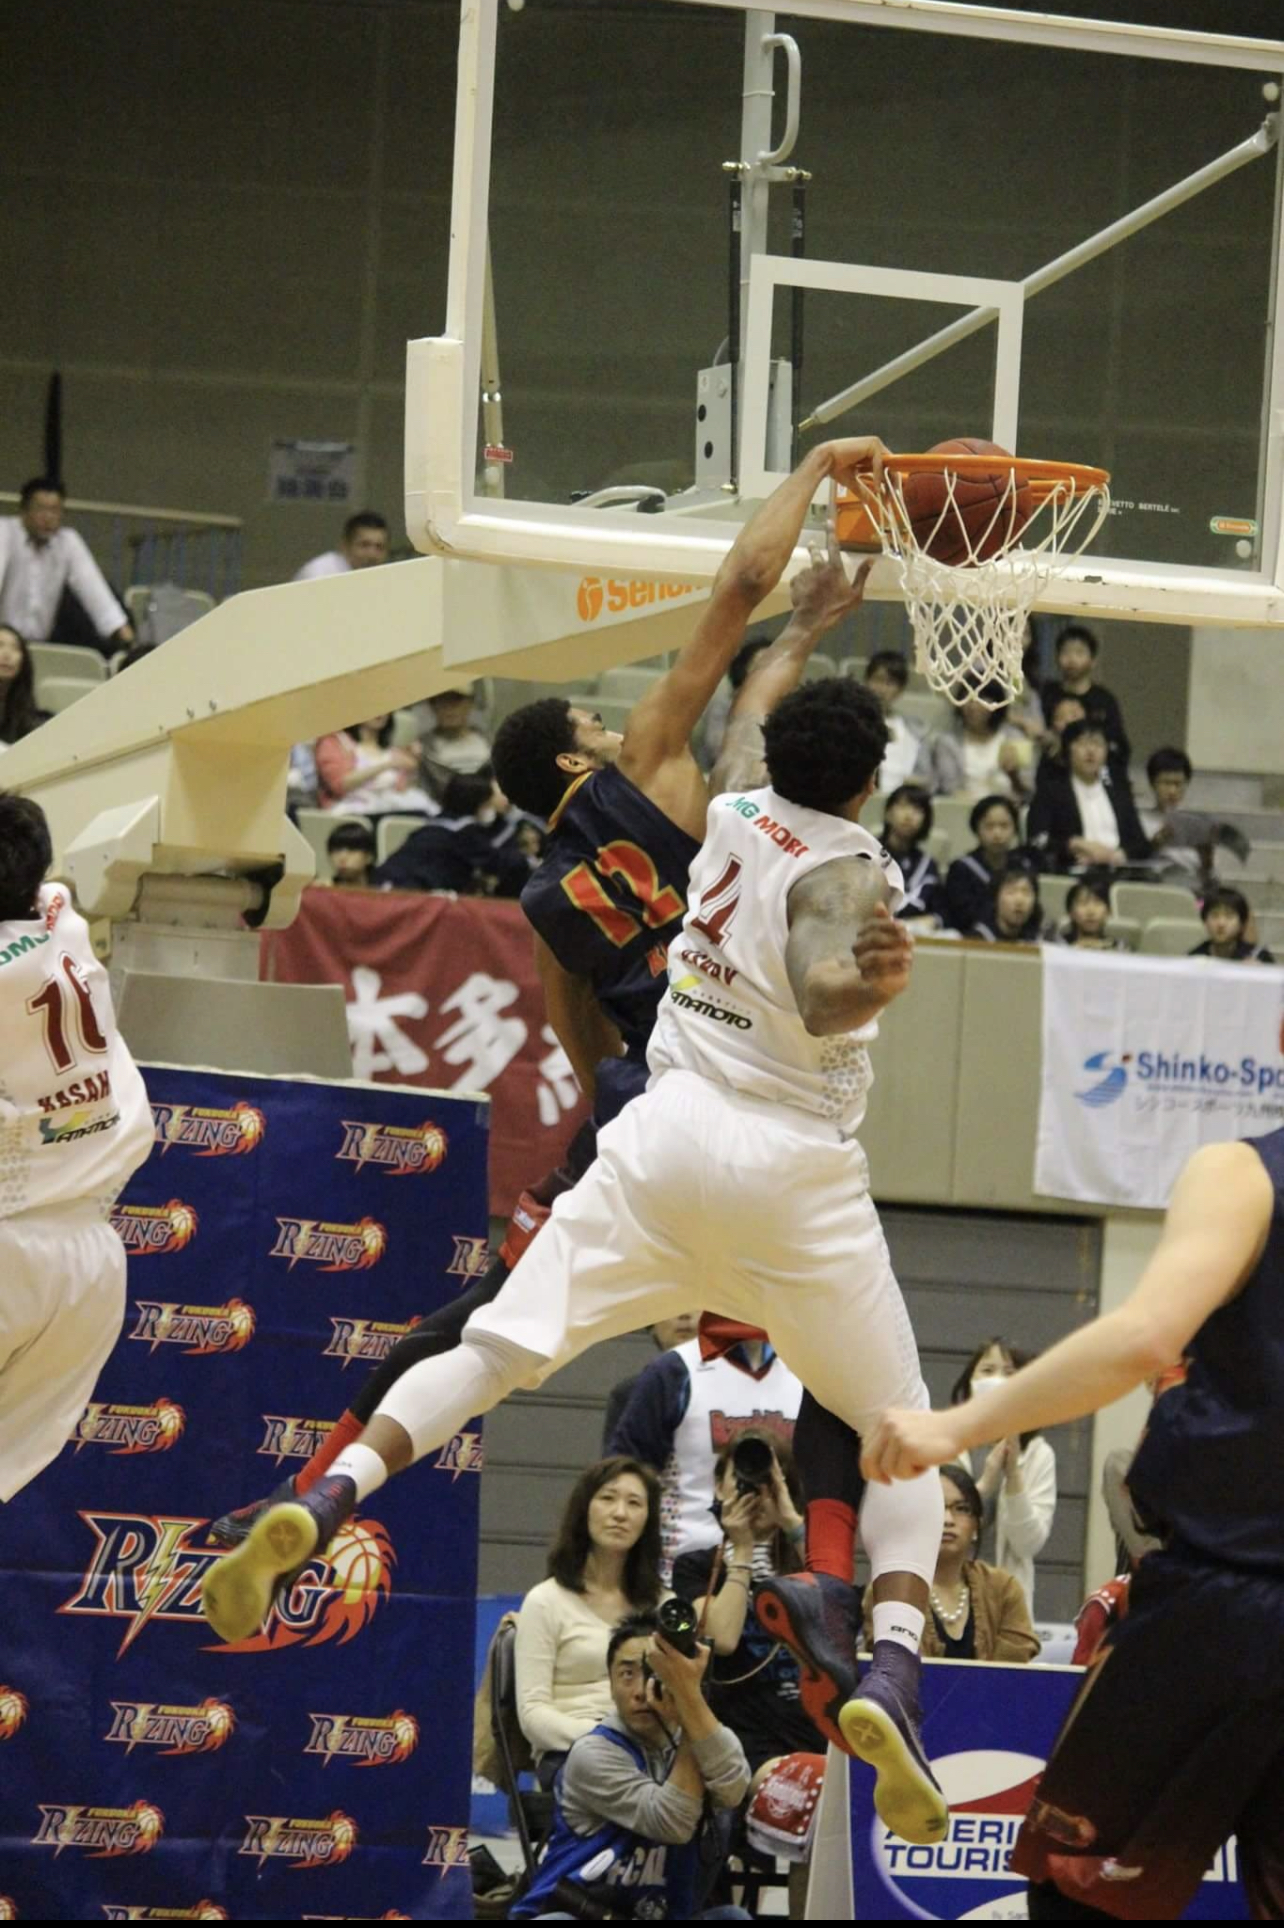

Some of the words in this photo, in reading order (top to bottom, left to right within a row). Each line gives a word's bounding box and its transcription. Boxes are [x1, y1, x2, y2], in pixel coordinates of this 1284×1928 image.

[726, 796, 760, 819] MG
[560, 840, 687, 948] 12
[691, 853, 743, 950] 4
[335, 1121, 428, 1174] RIZING
[269, 1217, 365, 1272] RIZING
[128, 1301, 234, 1355] RIZING
[104, 1702, 210, 1756] RIZING
[303, 1713, 398, 1768] RIZING
[30, 1805, 141, 1860] RIZING
[238, 1815, 336, 1869] RIZING
